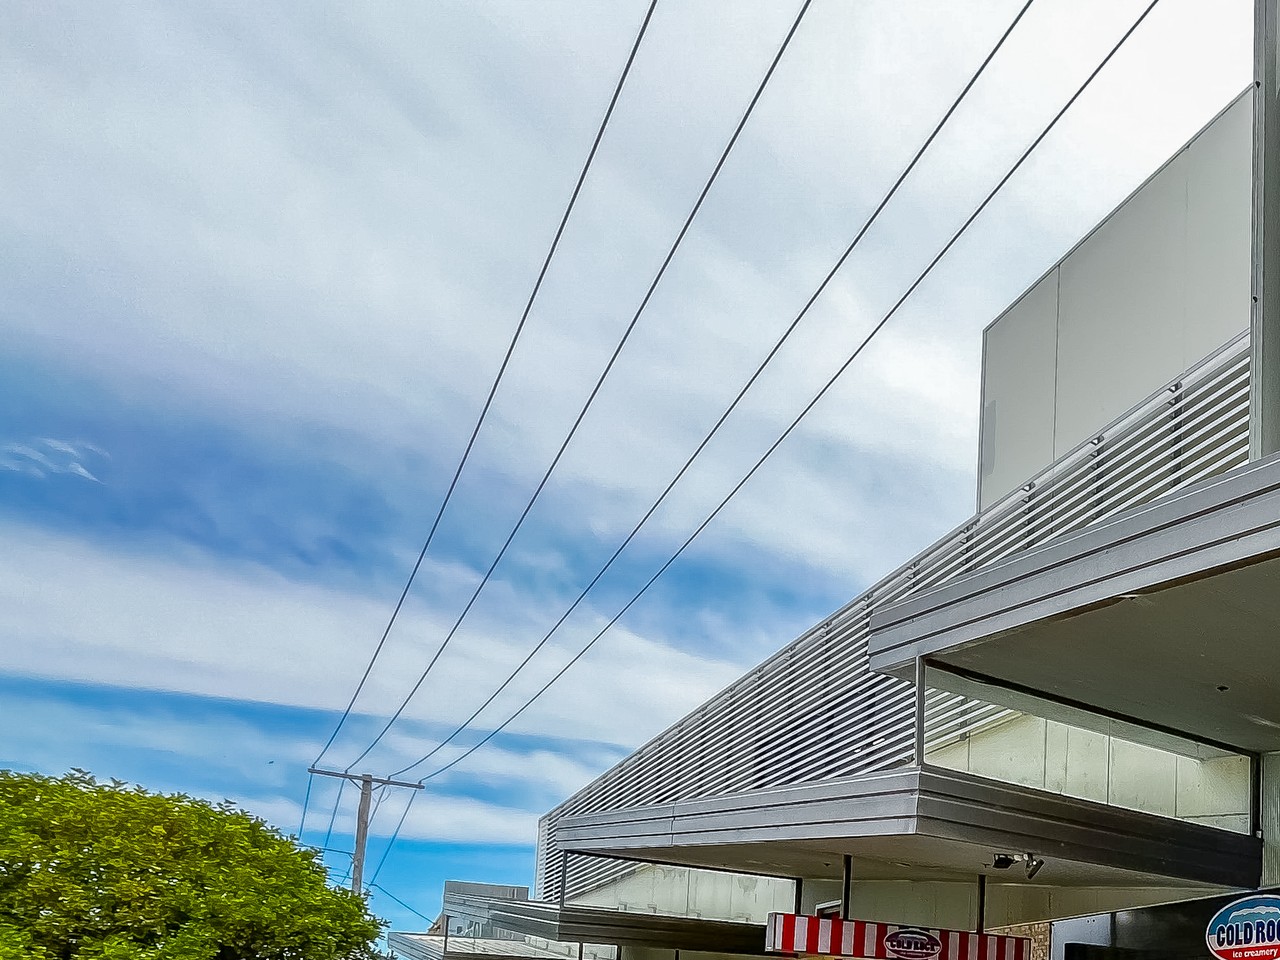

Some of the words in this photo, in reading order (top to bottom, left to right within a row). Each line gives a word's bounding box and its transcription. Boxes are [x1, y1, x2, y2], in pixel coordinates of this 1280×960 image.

[1216, 921, 1254, 947] COLD
[1232, 950, 1242, 959] ice
[1244, 948, 1279, 958] creamery
